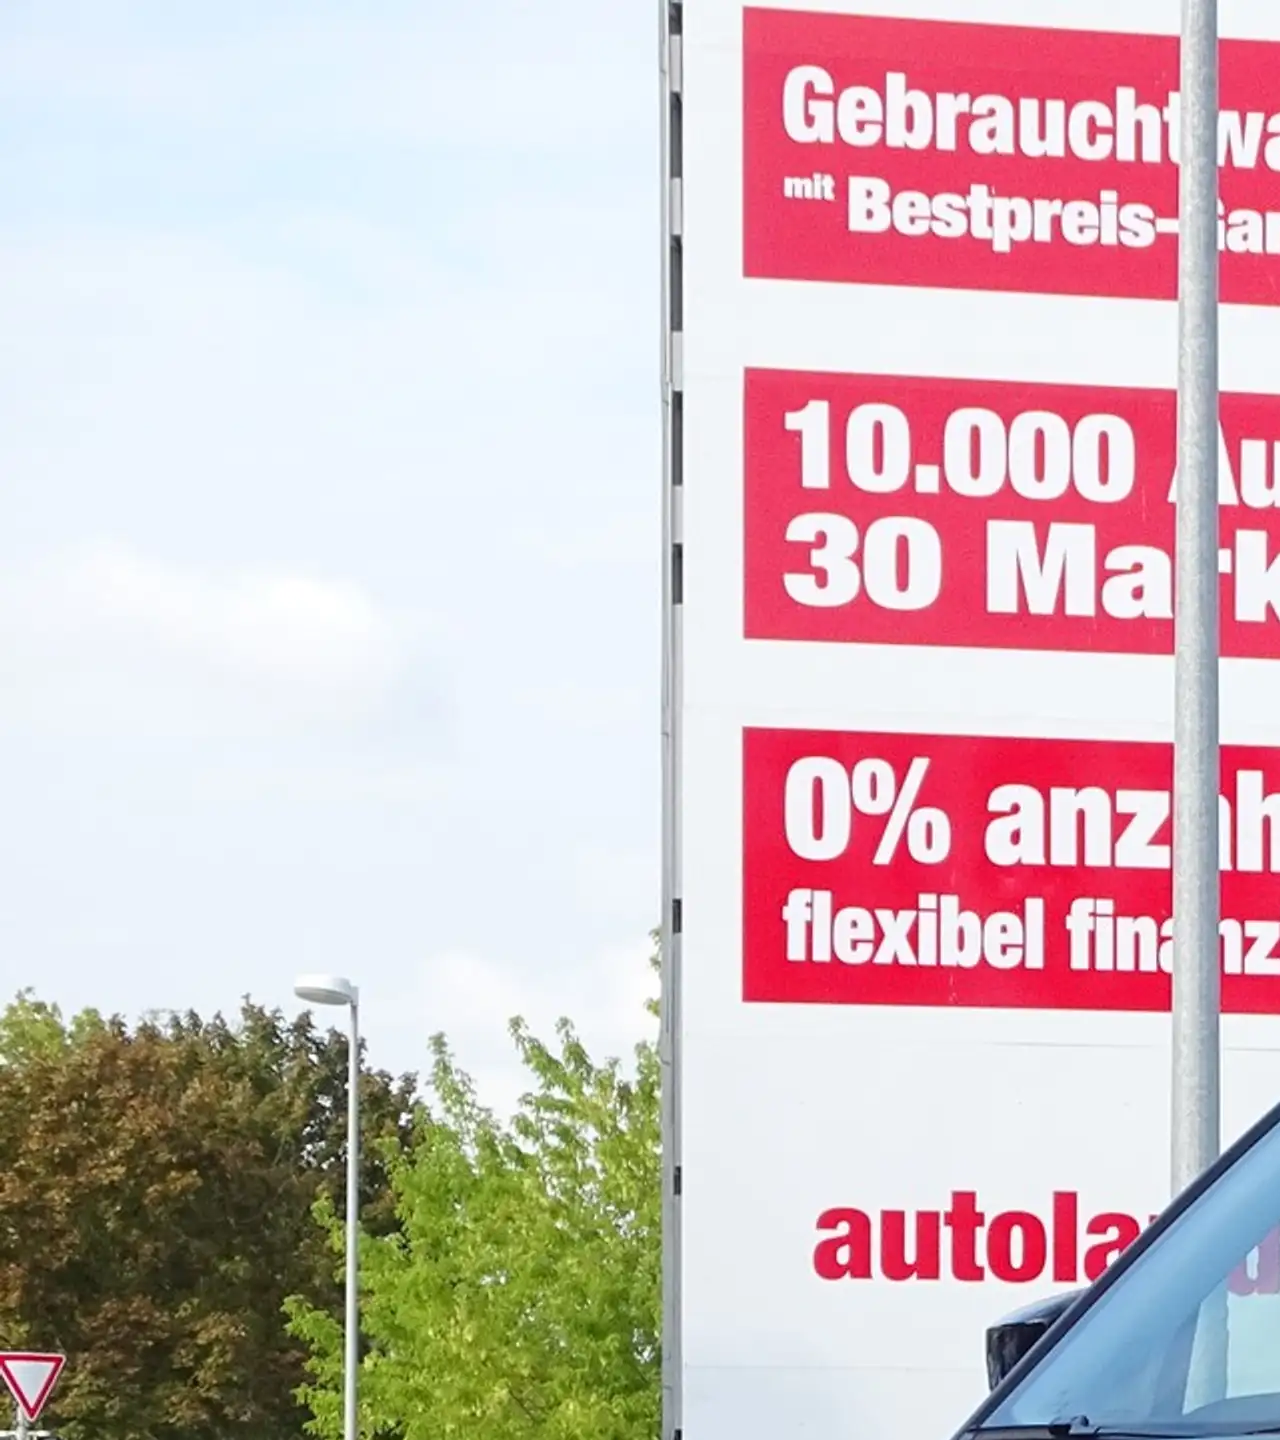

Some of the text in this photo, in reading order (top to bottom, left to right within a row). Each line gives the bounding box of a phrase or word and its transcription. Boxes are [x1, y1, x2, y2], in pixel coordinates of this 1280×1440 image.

[784, 174, 835, 200] mit
[785, 401, 1135, 503] 10.000
[783, 513, 942, 610] 30
[785, 756, 951, 865] 0%
[782, 889, 1044, 969] flexibel
